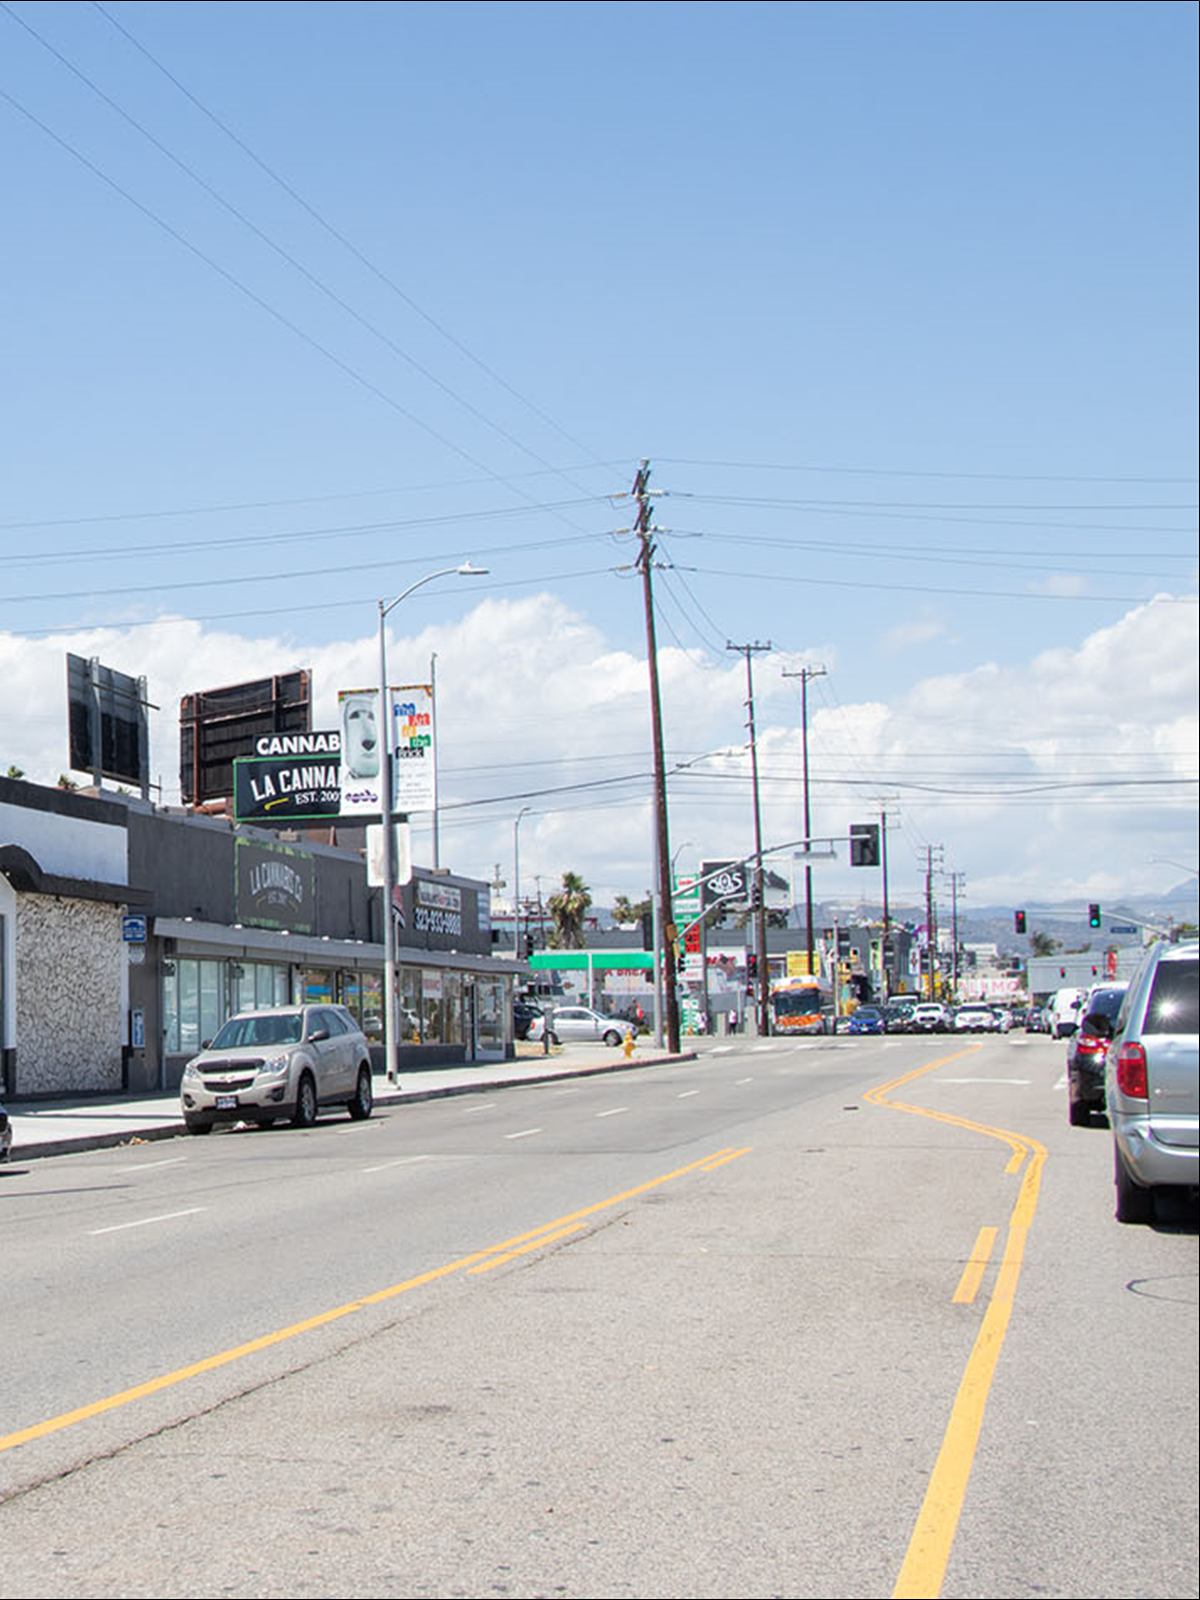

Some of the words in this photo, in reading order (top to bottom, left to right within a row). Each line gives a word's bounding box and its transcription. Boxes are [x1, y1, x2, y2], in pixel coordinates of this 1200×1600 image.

[257, 734, 340, 755] CANNAB
[250, 775, 276, 801] LA
[279, 766, 340, 793] CANNA
[295, 791, 317, 805] EST.
[320, 790, 340, 803] 200
